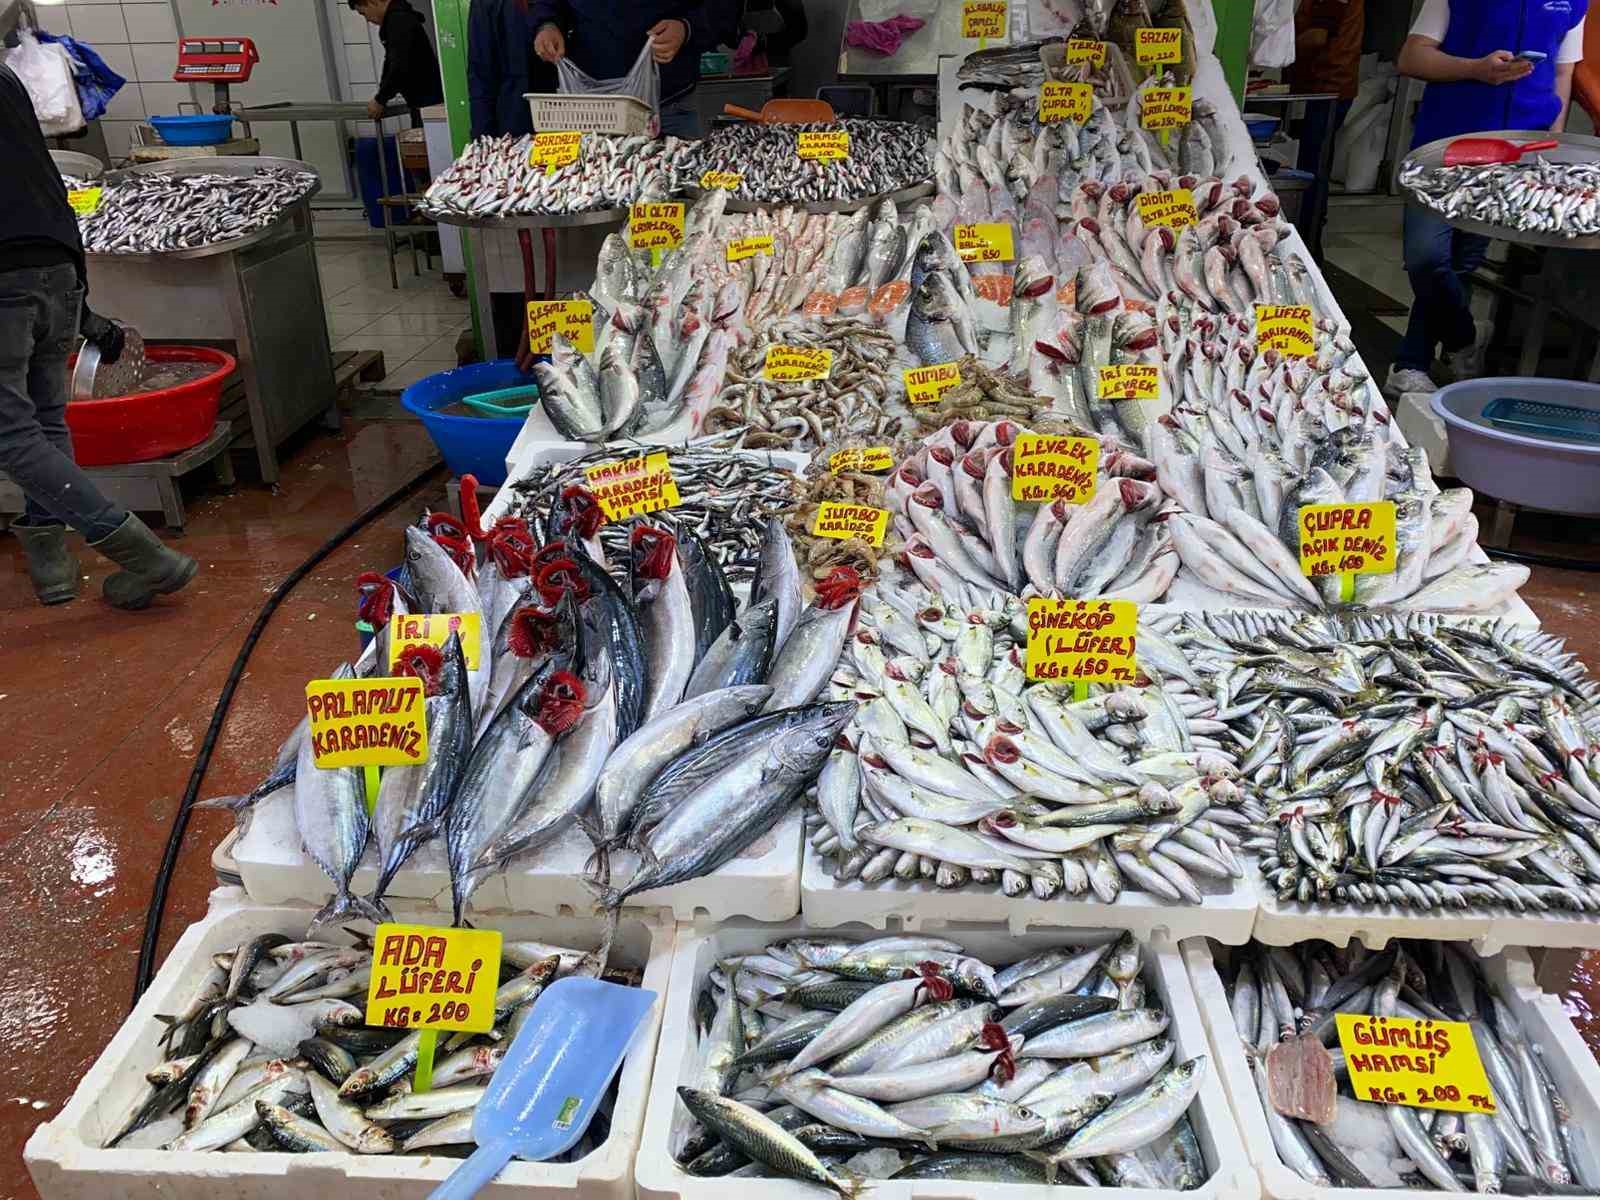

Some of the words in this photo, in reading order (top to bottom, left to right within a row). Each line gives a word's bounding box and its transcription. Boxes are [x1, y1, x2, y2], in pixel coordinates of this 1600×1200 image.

[1140, 31, 1180, 44] SAZAN
[1044, 86, 1073, 97] OLTA
[1144, 92, 1171, 103] OLTA
[1042, 99, 1076, 112] ÇUPRA
[1140, 191, 1174, 207] DİDİM
[633, 203, 647, 218] İRİ
[651, 205, 679, 218] OLTA
[529, 302, 568, 325] ÇEŞME
[1260, 306, 1311, 325] LÜFER
[530, 321, 557, 340] OLTA
[908, 367, 957, 385] JUMBO
[1100, 364, 1121, 381] İRİ
[1126, 366, 1158, 377] OLTA
[1102, 378, 1158, 398] LEVREK
[1020, 439, 1093, 465] LEVREK
[592, 469, 674, 501] KARADENİZ
[607, 486, 664, 511] HAMSİ
[823, 507, 880, 522] JUMBO
[1303, 508, 1373, 538] ÇUPRA
[819, 519, 875, 533] KARİDES
[1302, 537, 1340, 557] AÇIK
[1343, 536, 1388, 561] DENİZ
[1028, 605, 1115, 640] ÇİNEKOP
[1034, 662, 1069, 679] KG:
[1072, 658, 1110, 679] 450
[1110, 667, 1135, 681] TL
[308, 687, 421, 723] PALAMUT
[311, 720, 422, 759] KARADENİZ
[379, 934, 448, 968] ADA
[375, 958, 484, 1000] LÜFERİ
[425, 1000, 470, 1023] 200
[1353, 1016, 1451, 1058] GÜMÜŞ
[1416, 1084, 1461, 1104] 200
